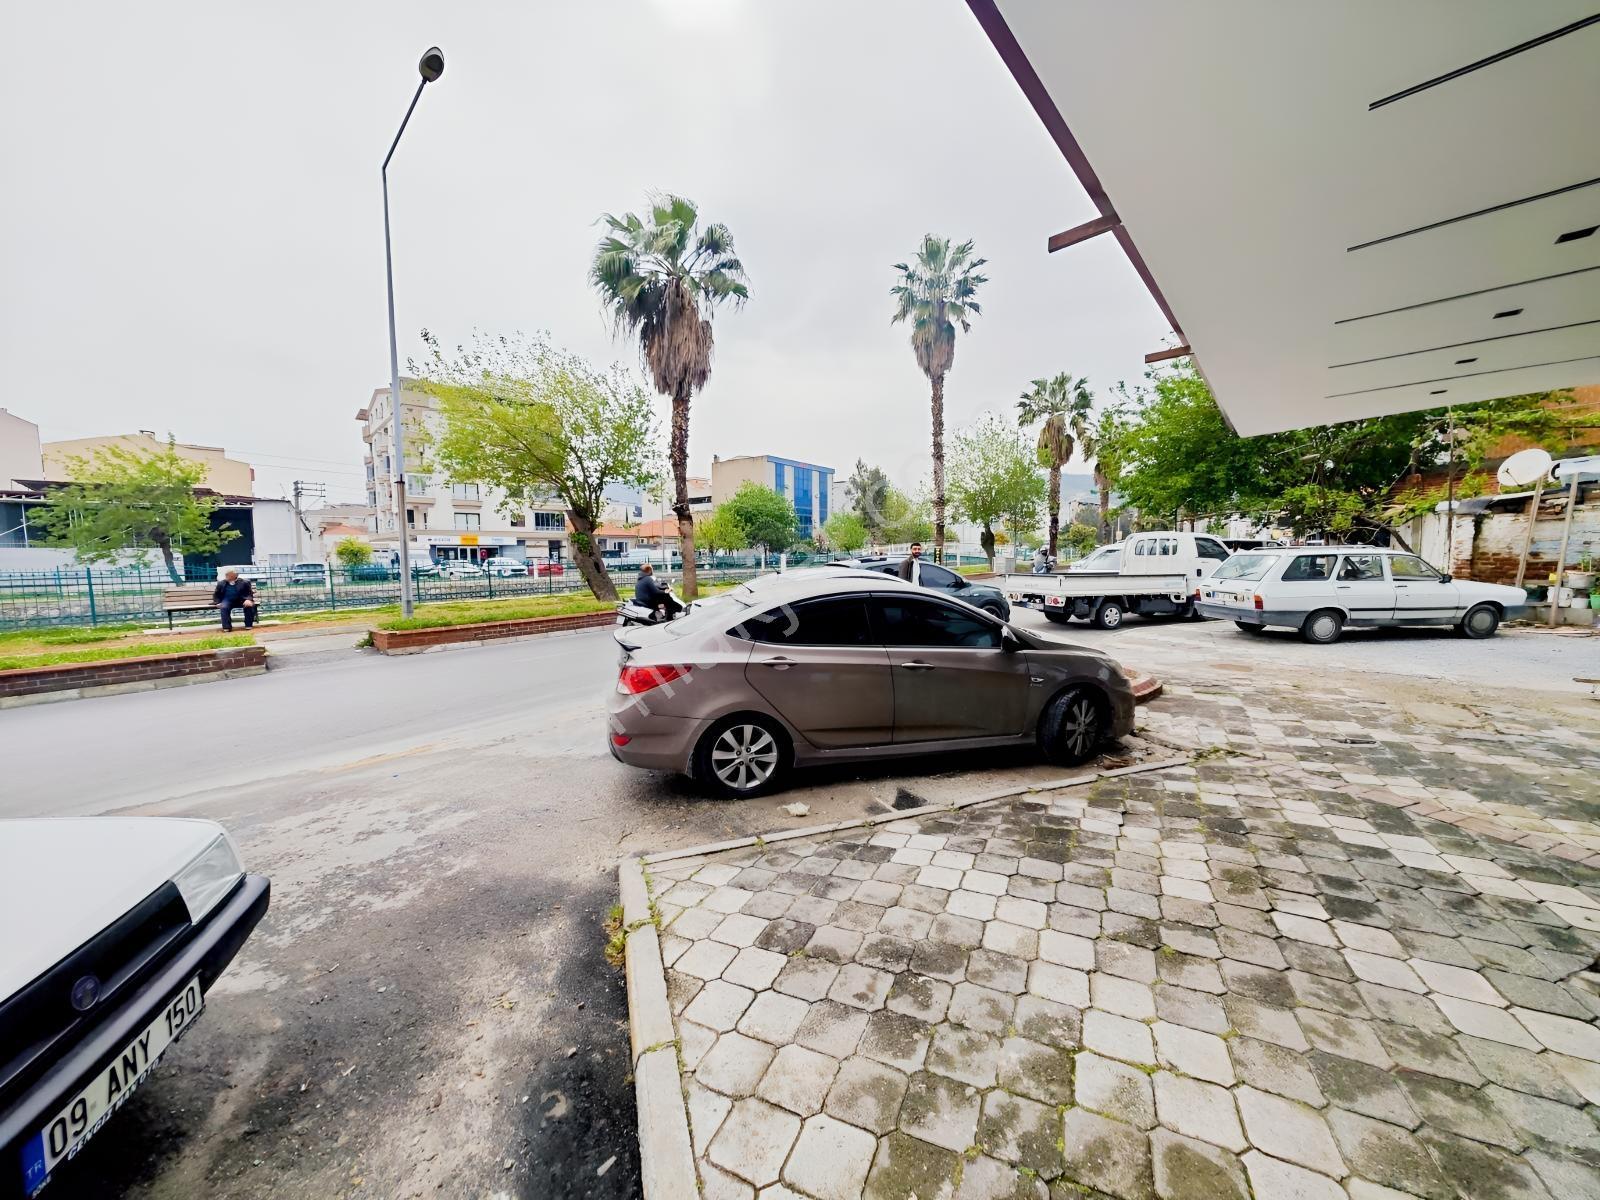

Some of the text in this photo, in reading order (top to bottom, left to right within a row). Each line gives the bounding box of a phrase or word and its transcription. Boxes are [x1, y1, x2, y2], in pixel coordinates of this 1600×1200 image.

[49, 1098, 87, 1158] 09
[107, 1030, 150, 1104] ANY
[165, 986, 196, 1037] 150
[26, 1159, 43, 1180] TR
